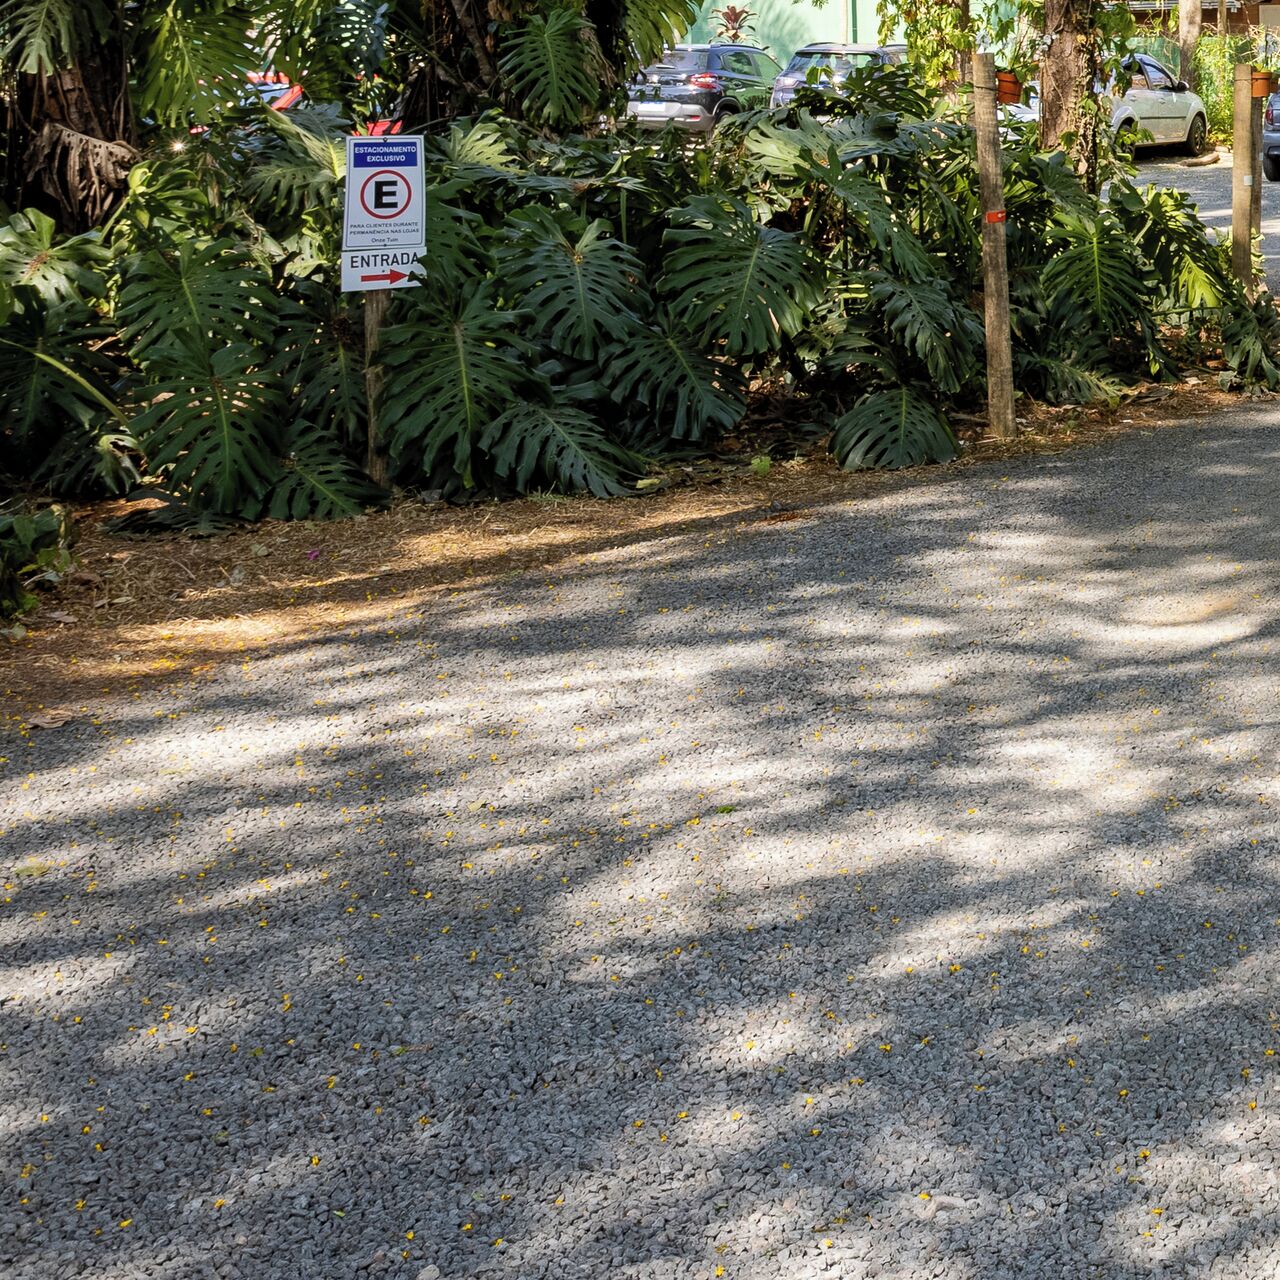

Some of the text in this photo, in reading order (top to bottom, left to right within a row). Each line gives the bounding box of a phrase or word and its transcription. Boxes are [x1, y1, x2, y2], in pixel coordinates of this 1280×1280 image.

[354, 146, 417, 154] ESTACIONAMENTO
[374, 180, 398, 209] E
[350, 252, 418, 269] ENTRADA
